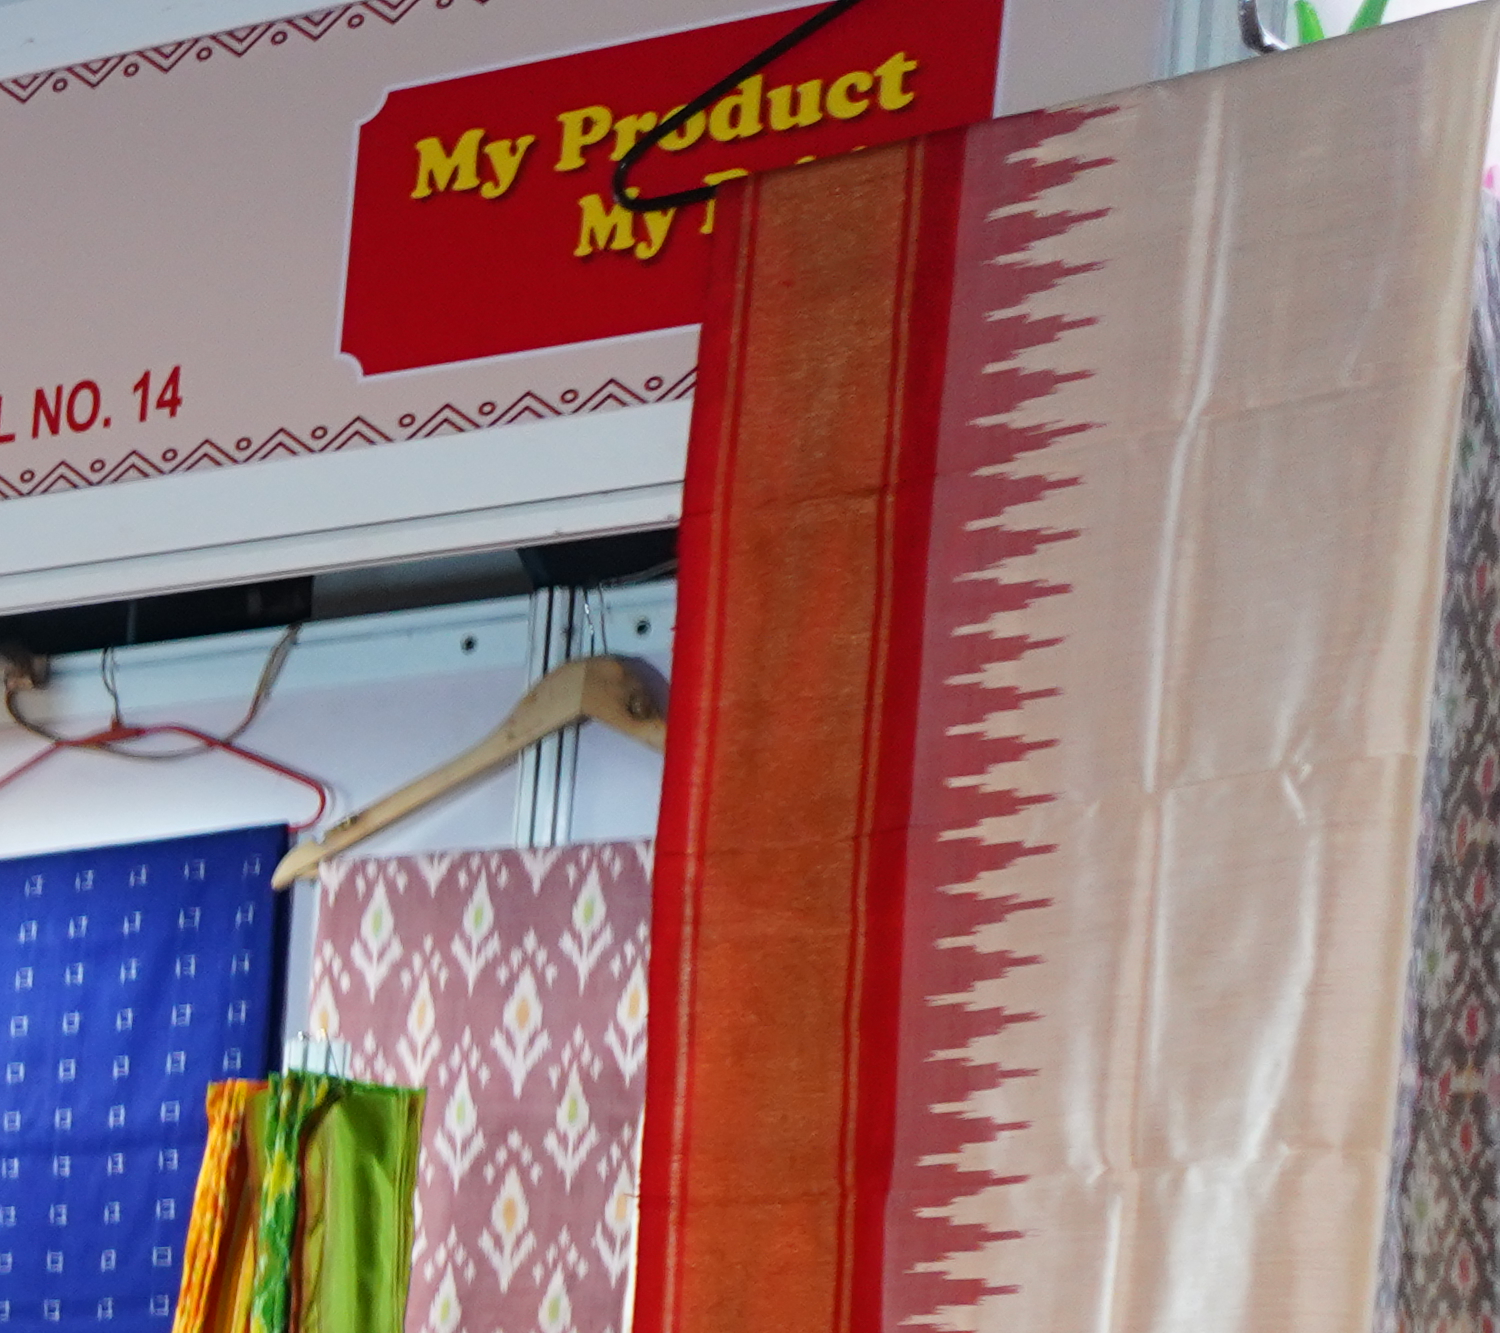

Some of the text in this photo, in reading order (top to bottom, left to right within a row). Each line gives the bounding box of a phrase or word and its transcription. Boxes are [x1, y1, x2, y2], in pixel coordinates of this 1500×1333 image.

[411, 51, 918, 200] My Product
[575, 186, 677, 260] My
[30, 378, 107, 441] NO.
[132, 364, 184, 424] 14
